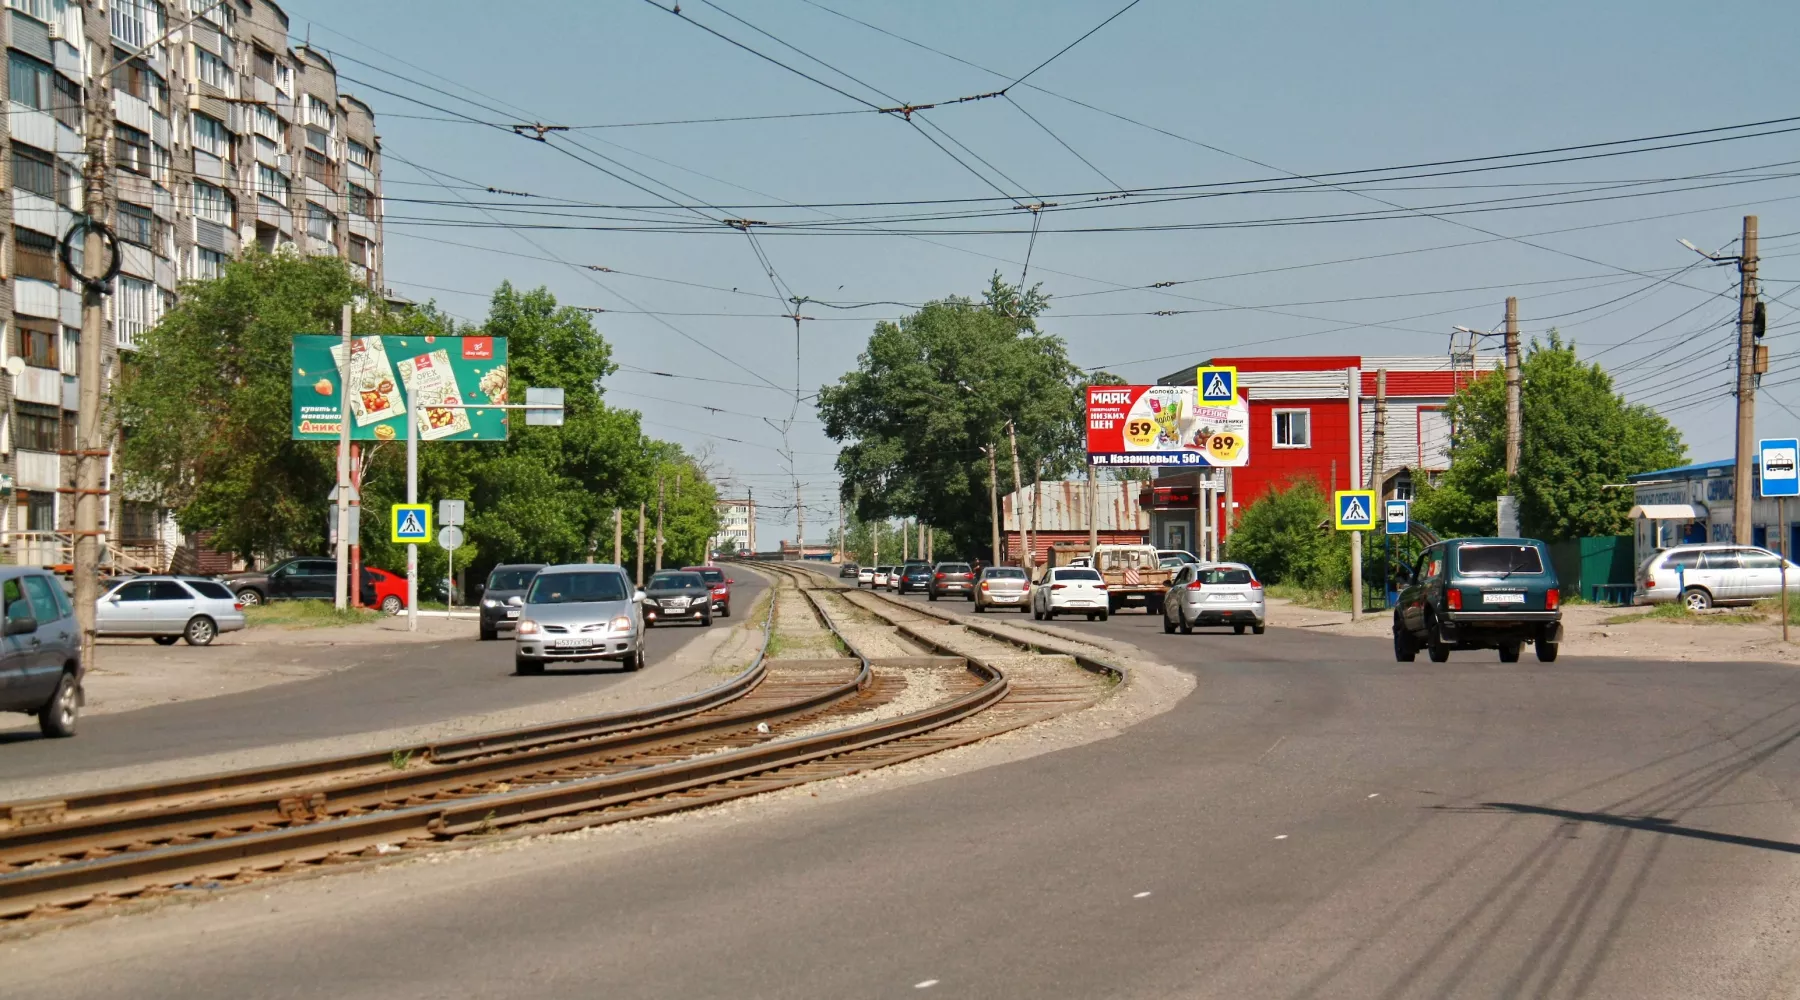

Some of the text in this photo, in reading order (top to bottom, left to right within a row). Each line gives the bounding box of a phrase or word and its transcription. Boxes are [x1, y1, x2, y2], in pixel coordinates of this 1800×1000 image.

[1091, 393, 1131, 404] МАЯК
[301, 406, 331, 414] купить
[1091, 412, 1125, 420] НИЗКИХ
[1091, 420, 1113, 429] ЦЕН
[1130, 422, 1152, 436] 59
[1212, 436, 1234, 450] 89
[1093, 454, 1108, 465] ул.
[1110, 453, 1180, 465] Казанцевых,
